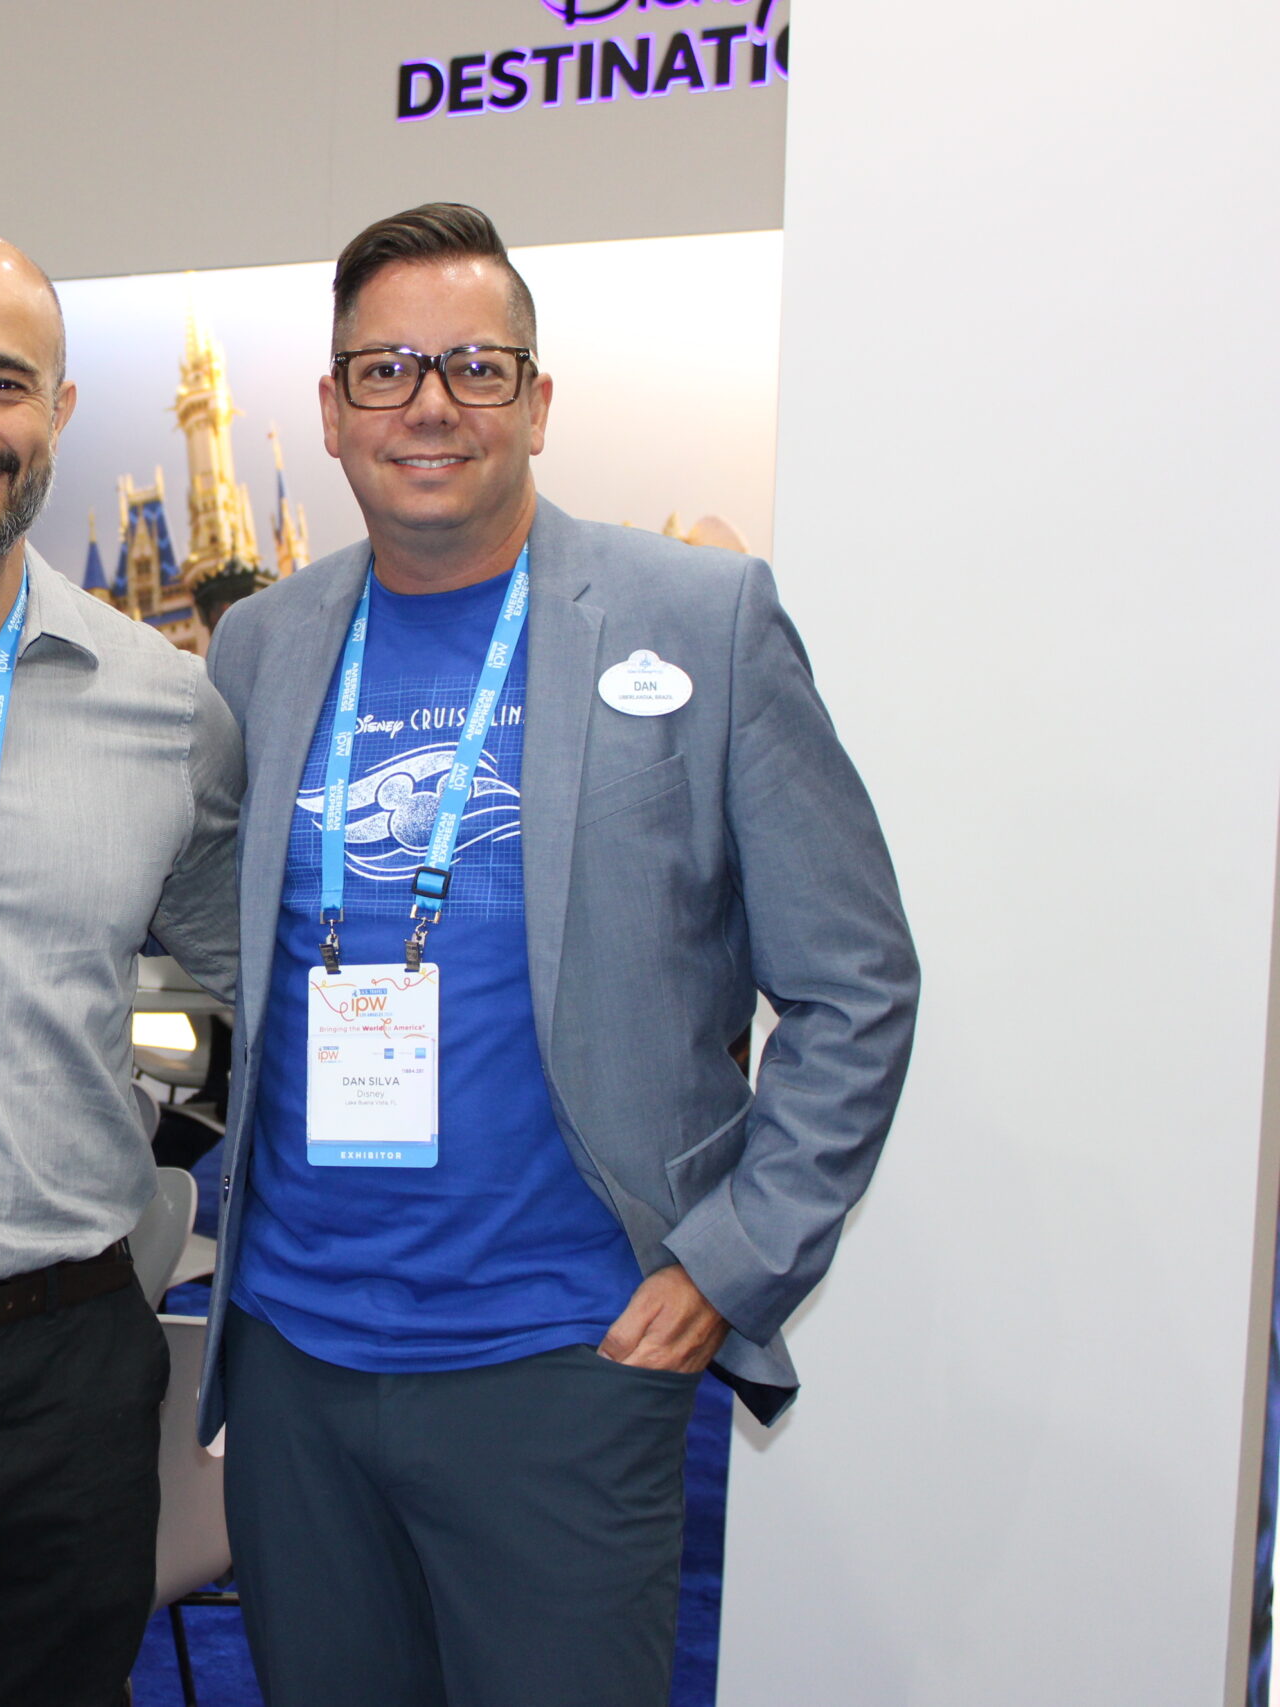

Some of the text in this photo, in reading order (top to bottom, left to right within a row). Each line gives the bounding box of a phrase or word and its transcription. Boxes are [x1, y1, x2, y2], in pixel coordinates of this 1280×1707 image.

[503, 571, 527, 622] AMERICAN
[491, 642, 510, 669] ipw
[341, 668, 352, 713] EXPRESS
[348, 662, 359, 712] AMERICAN
[633, 681, 657, 691] DAN
[410, 707, 466, 731] CRUIS
[491, 704, 524, 727] LIN
[465, 688, 488, 741] AMERICAN
[475, 689, 496, 736] EXPRESS
[453, 763, 470, 791] ipw
[326, 785, 337, 832] EXPRESS
[333, 778, 345, 831] AMERICAN
[429, 811, 450, 868] AMERICAN
[438, 813, 457, 863] EXPRESS
[351, 995, 387, 1017] ipw
[342, 1077, 401, 1086] DAN SILVA
[357, 1089, 385, 1099] Disney
[340, 1151, 402, 1160] EXHIBITOR
